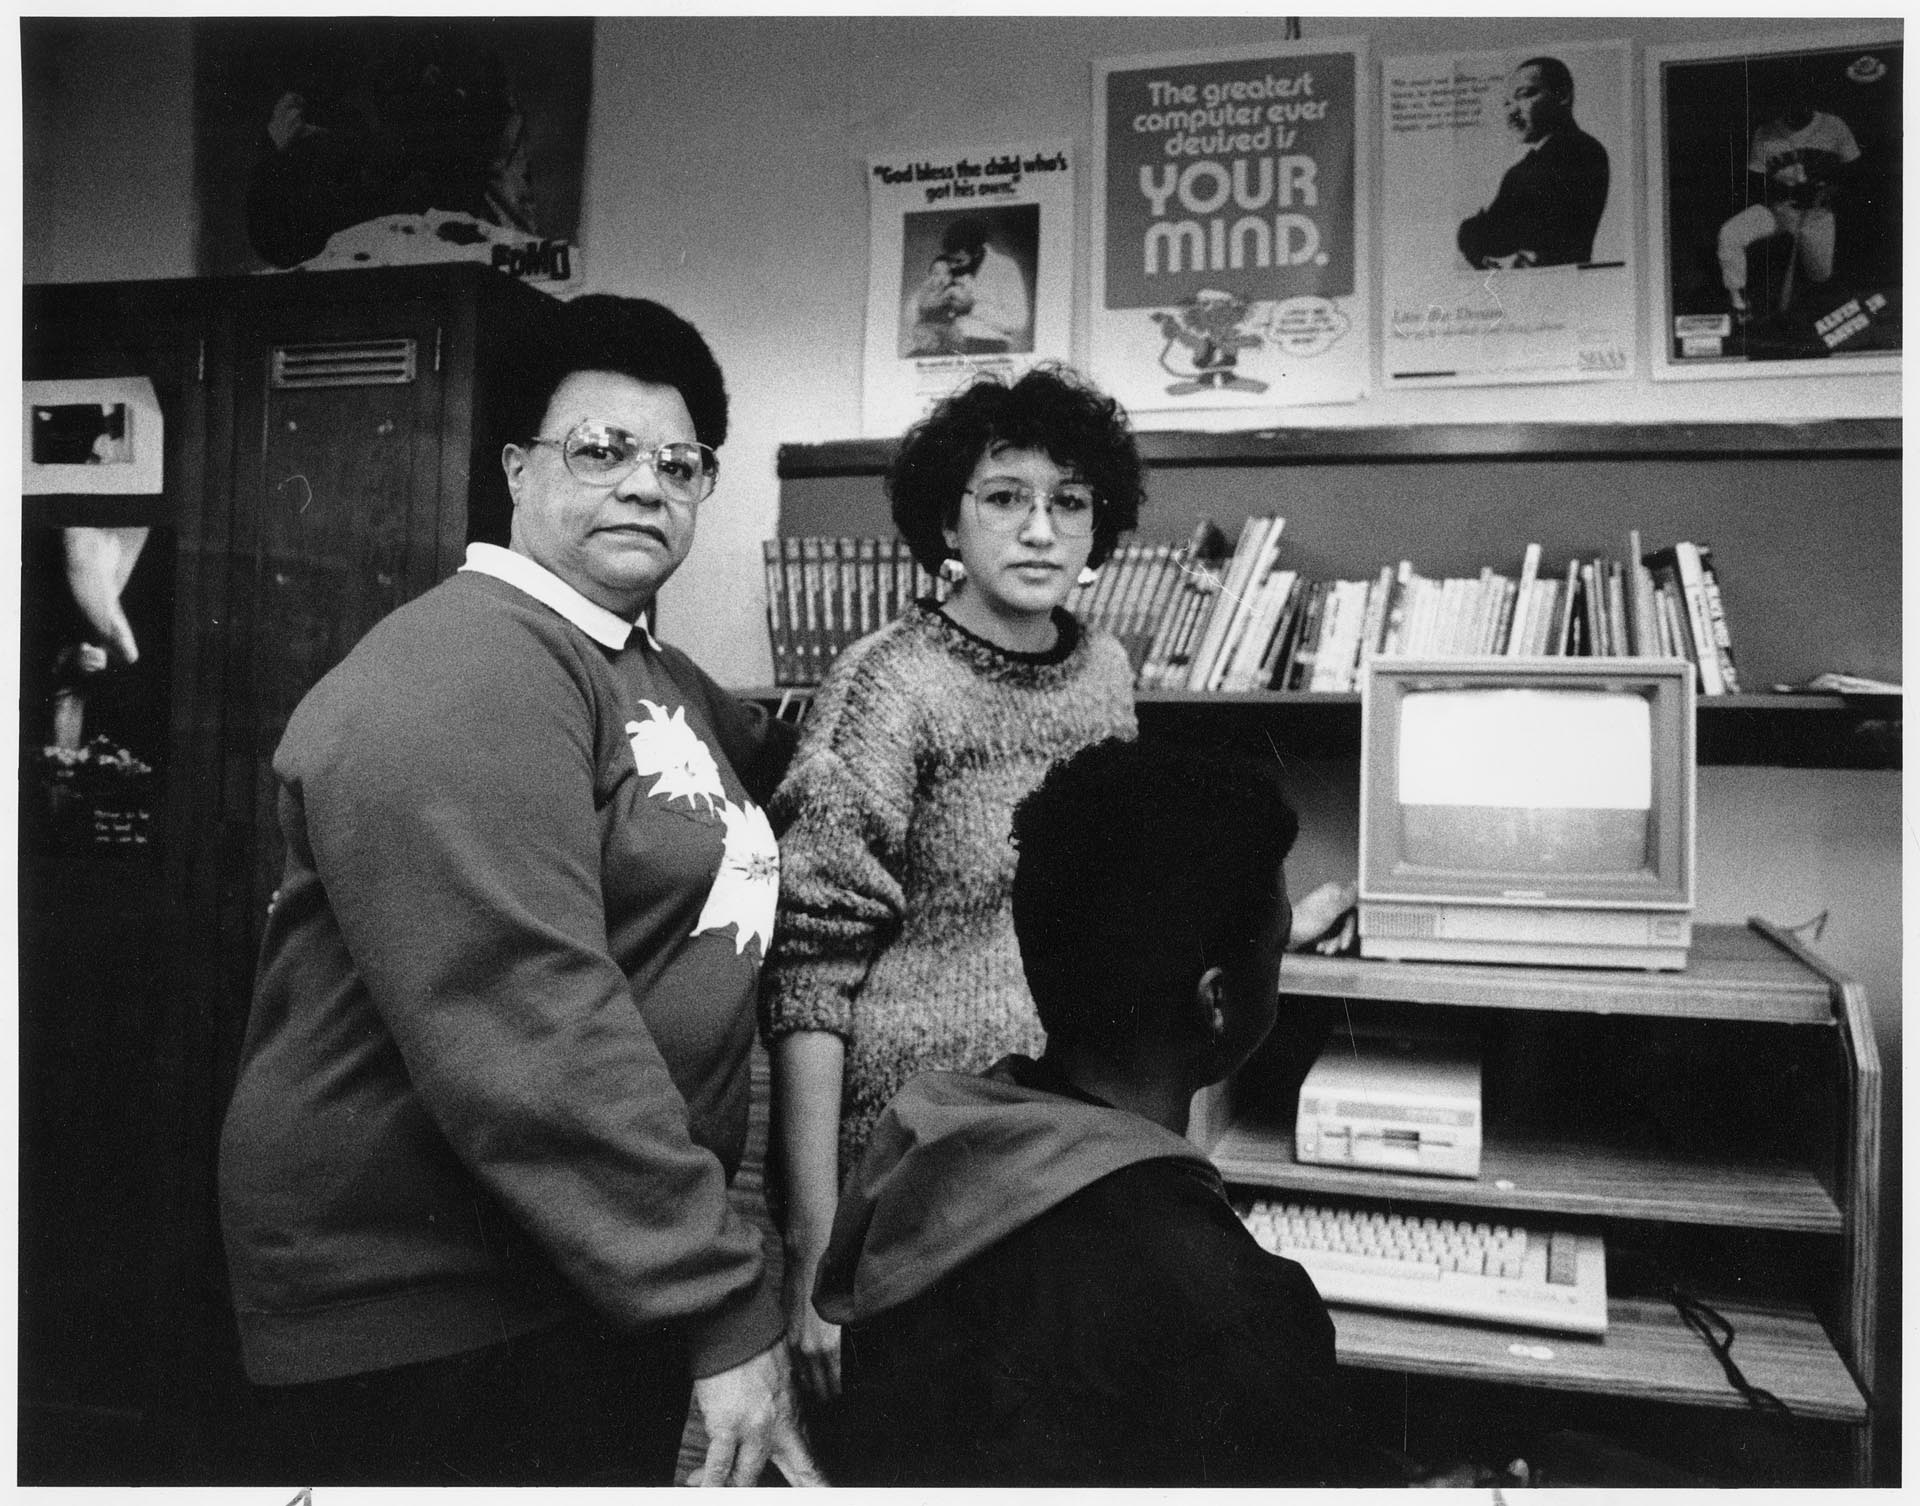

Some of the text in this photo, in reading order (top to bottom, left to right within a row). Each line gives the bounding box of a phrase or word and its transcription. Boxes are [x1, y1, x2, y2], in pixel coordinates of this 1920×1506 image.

[1149, 72, 1314, 108] The greatest
[1133, 101, 1328, 133] computer ever
[1164, 125, 1296, 155] devised is
[915, 162, 954, 181] bless
[956, 159, 981, 178] the
[984, 155, 1021, 176] child
[1023, 152, 1067, 173] who's
[926, 183, 950, 203] got
[953, 180, 975, 197] his
[1140, 154, 1318, 216] YOUR
[1144, 213, 1330, 275] MIND.
